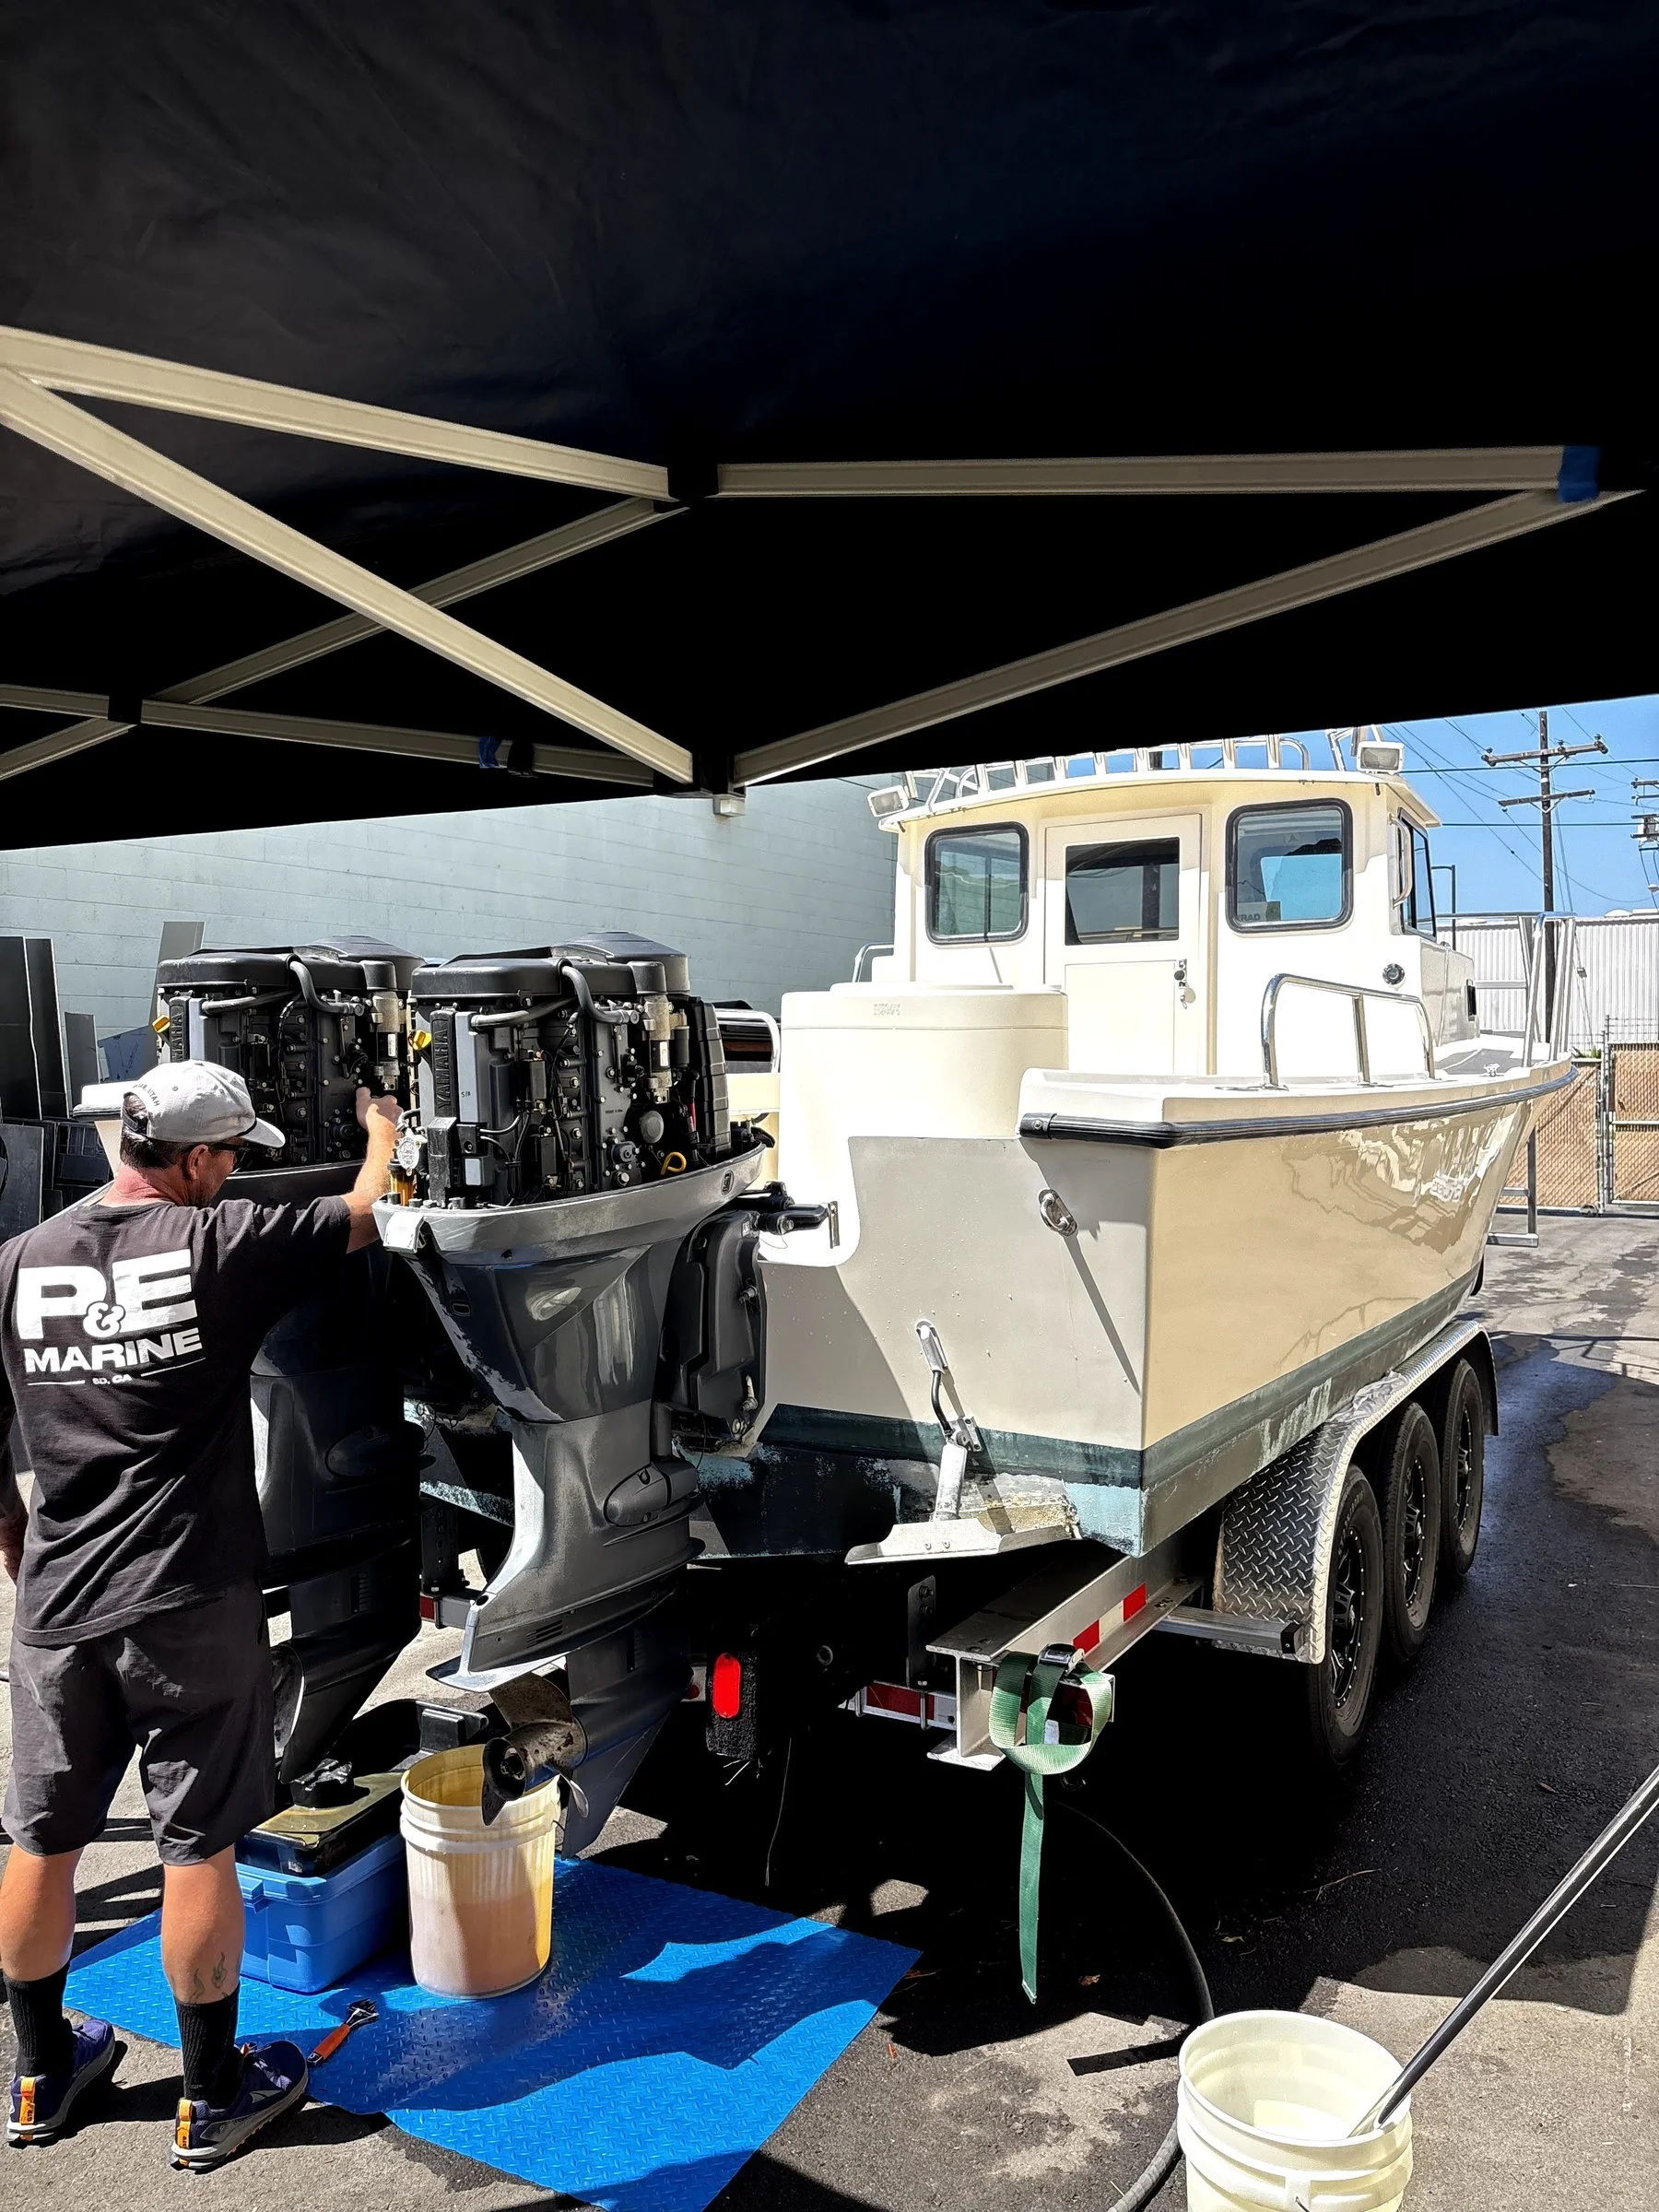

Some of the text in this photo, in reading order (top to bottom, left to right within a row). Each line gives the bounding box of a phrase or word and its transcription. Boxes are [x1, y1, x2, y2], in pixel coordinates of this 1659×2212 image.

[171, 1012, 184, 1062] MAHA
[434, 1029, 451, 1110] YAMAHA
[147, 1088, 160, 1106] UTAH
[17, 1249, 198, 1340] P&E
[24, 1328, 203, 1373] MARINE
[112, 1373, 132, 1384] CA
